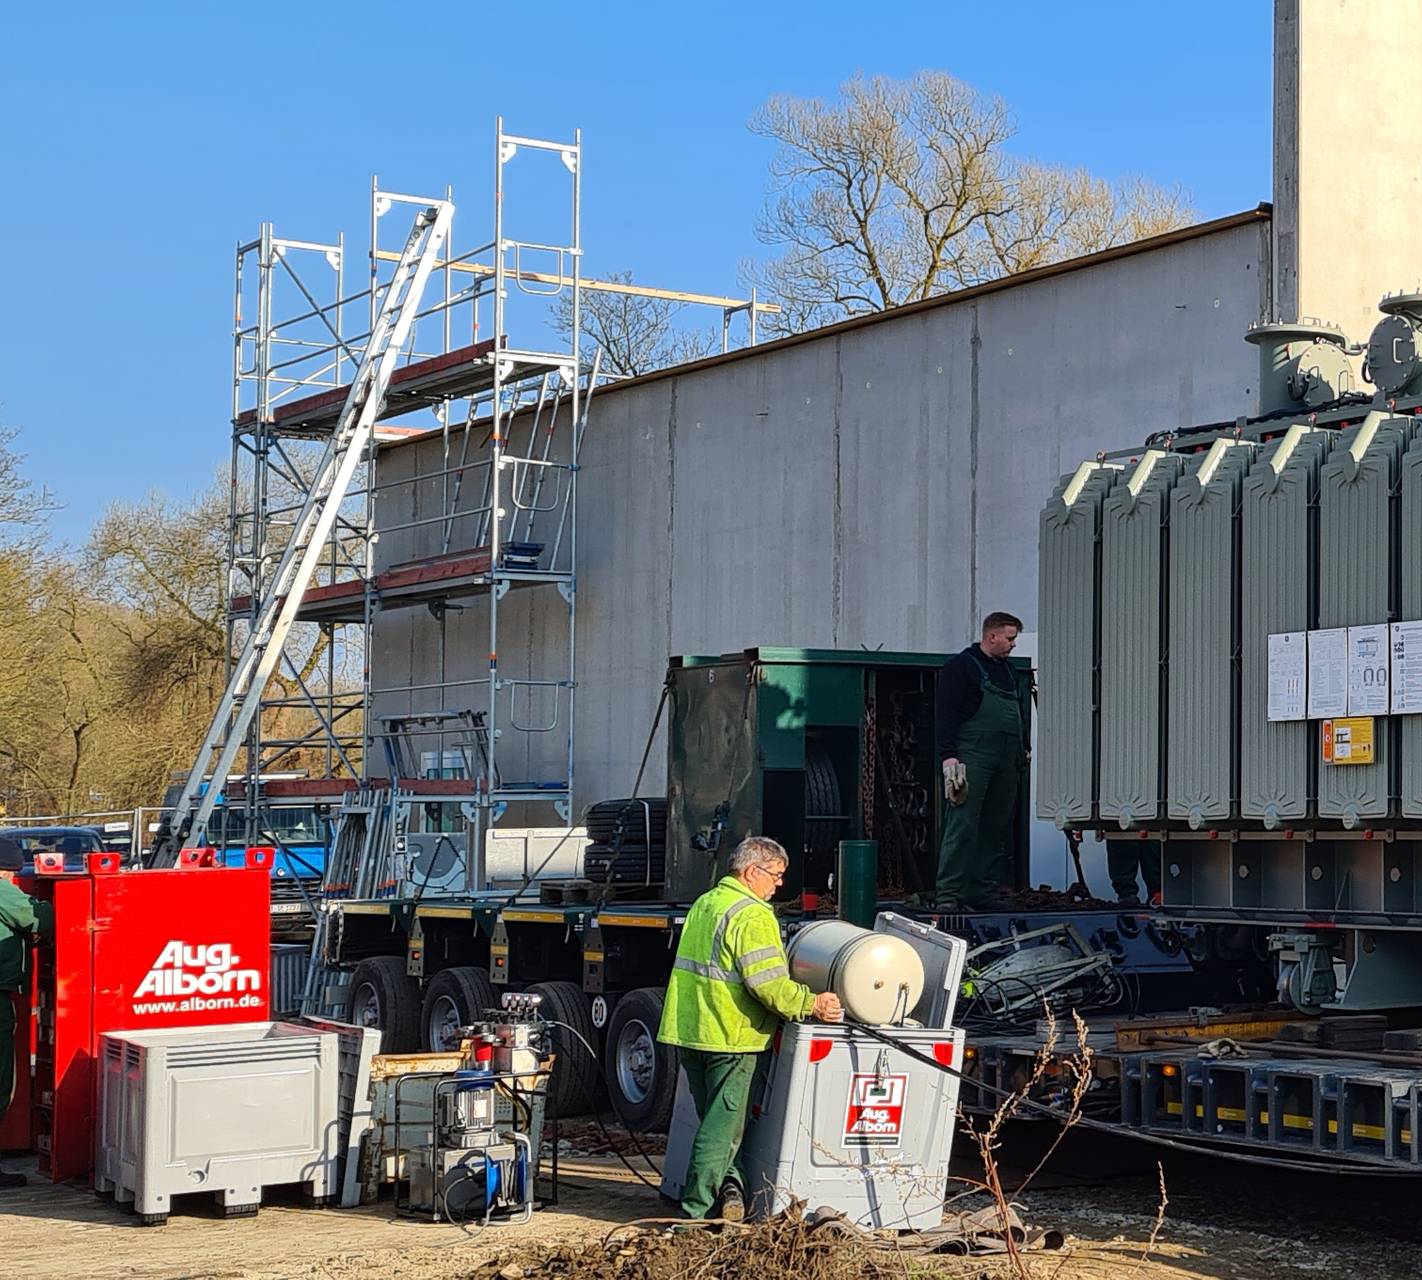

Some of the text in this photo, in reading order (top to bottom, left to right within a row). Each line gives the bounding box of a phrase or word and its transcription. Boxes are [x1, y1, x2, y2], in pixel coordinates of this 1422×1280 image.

[152, 940, 241, 973] Aug.
[133, 968, 260, 998] Alborn
[133, 994, 261, 1015] www.alborn.de
[594, 1001, 604, 1022] 80
[851, 1120, 897, 1132] Alborn
[860, 1108, 890, 1123] Aug.
